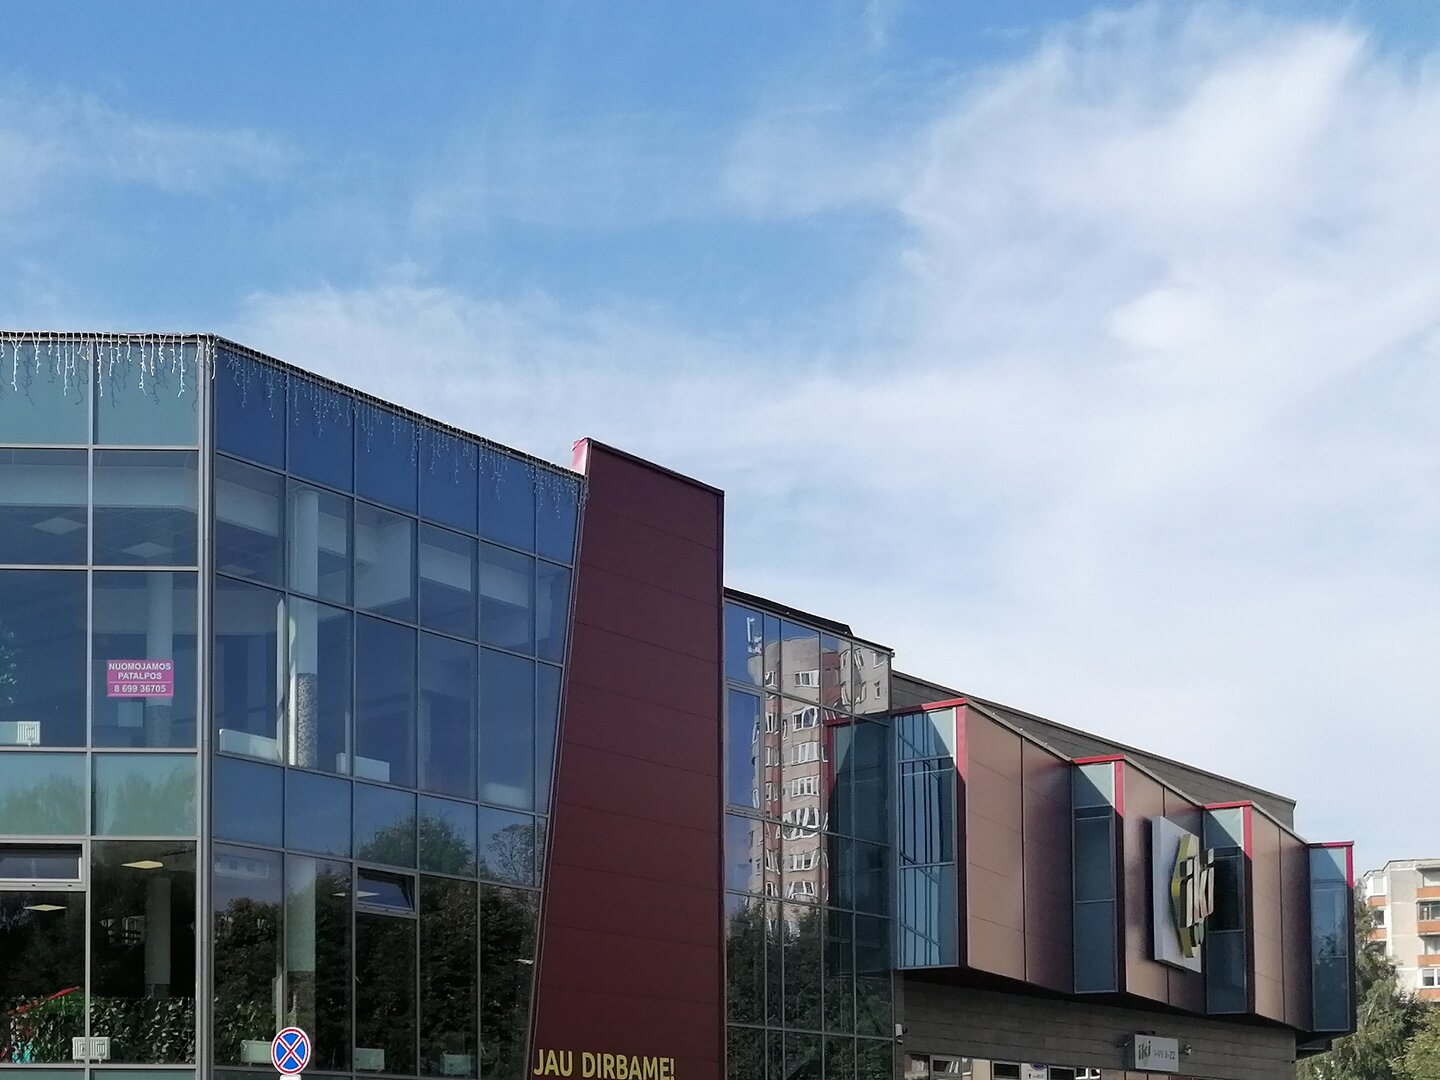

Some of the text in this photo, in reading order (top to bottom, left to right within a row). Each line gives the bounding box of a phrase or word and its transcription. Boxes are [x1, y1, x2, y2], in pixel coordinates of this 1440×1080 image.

[108, 662, 172, 671] NUOMOJAMOS
[118, 672, 162, 680] PATALPOS
[114, 684, 120, 693] 8
[140, 684, 167, 693] 36705
[1179, 847, 1215, 929] iki
[533, 1049, 573, 1077] JAU
